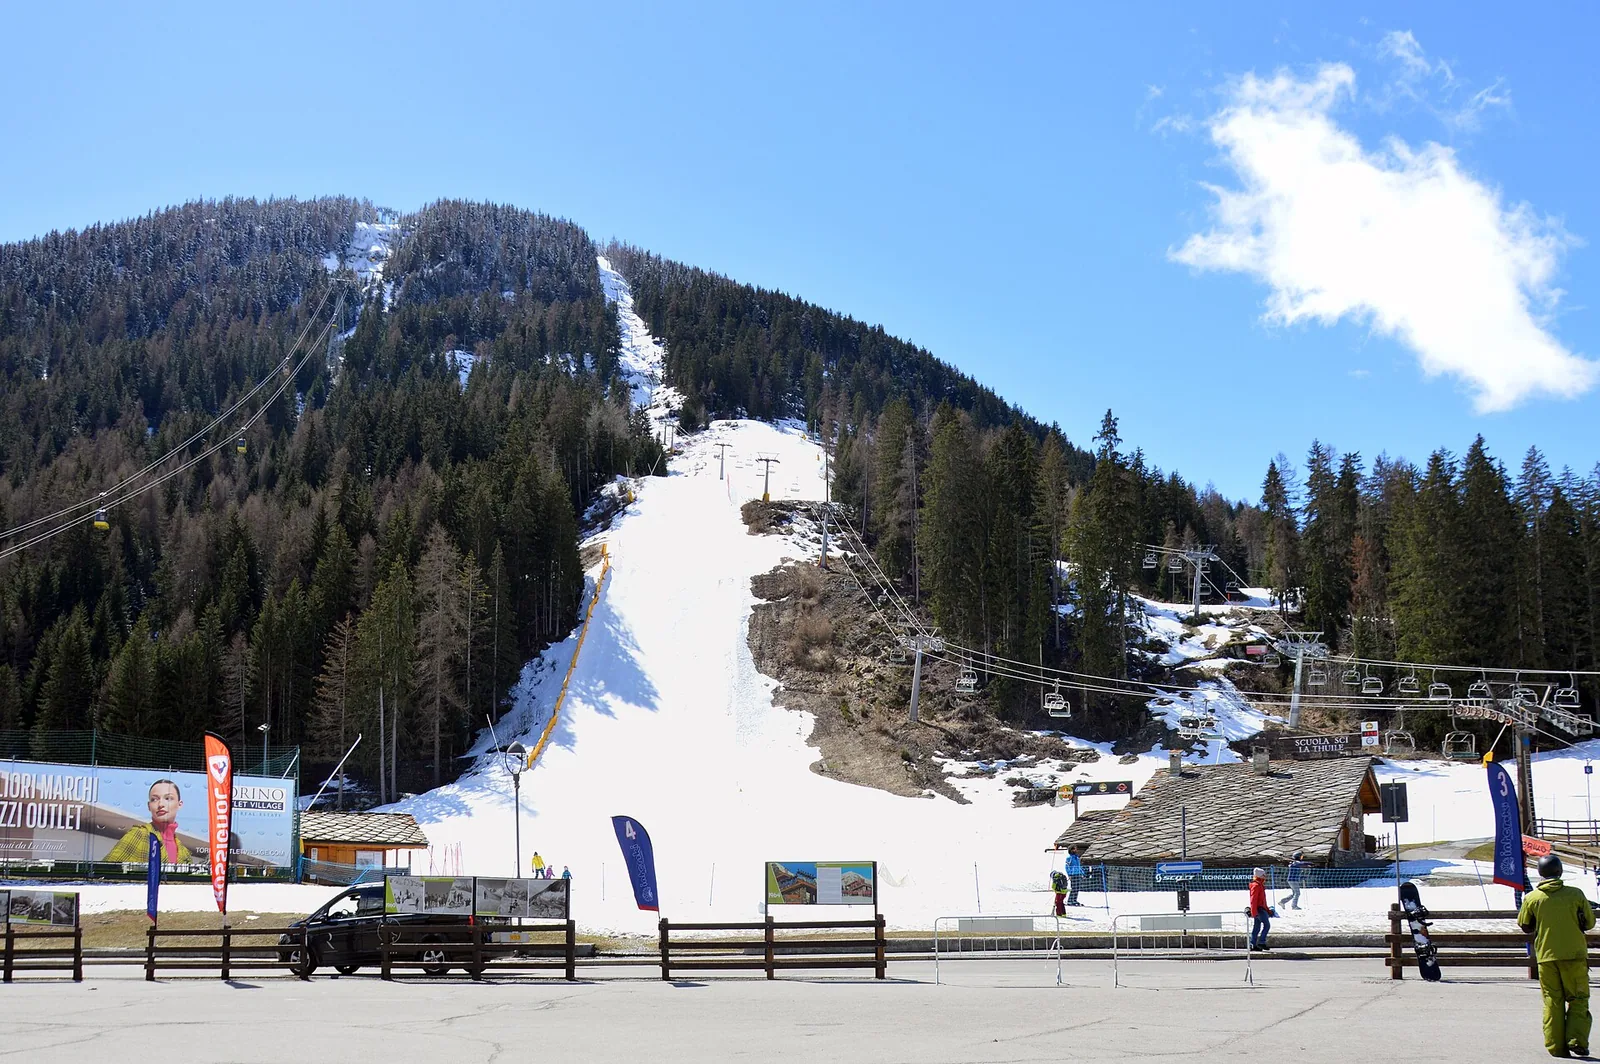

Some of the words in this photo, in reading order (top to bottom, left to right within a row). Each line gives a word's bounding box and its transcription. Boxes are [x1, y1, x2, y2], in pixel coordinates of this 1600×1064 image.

[1295, 737, 1330, 747] SCUOLA
[1334, 736, 1349, 744] SCI
[1313, 743, 1345, 752] THUILE
[0, 772, 37, 799] IORI
[40, 774, 99, 804] MARCHI
[1497, 771, 1508, 796] 3
[232, 800, 248, 808] LET
[250, 801, 283, 810] VILLAGE
[26, 802, 84, 830] OUTLET
[625, 820, 636, 840] 4
[151, 840, 157, 857] 5
